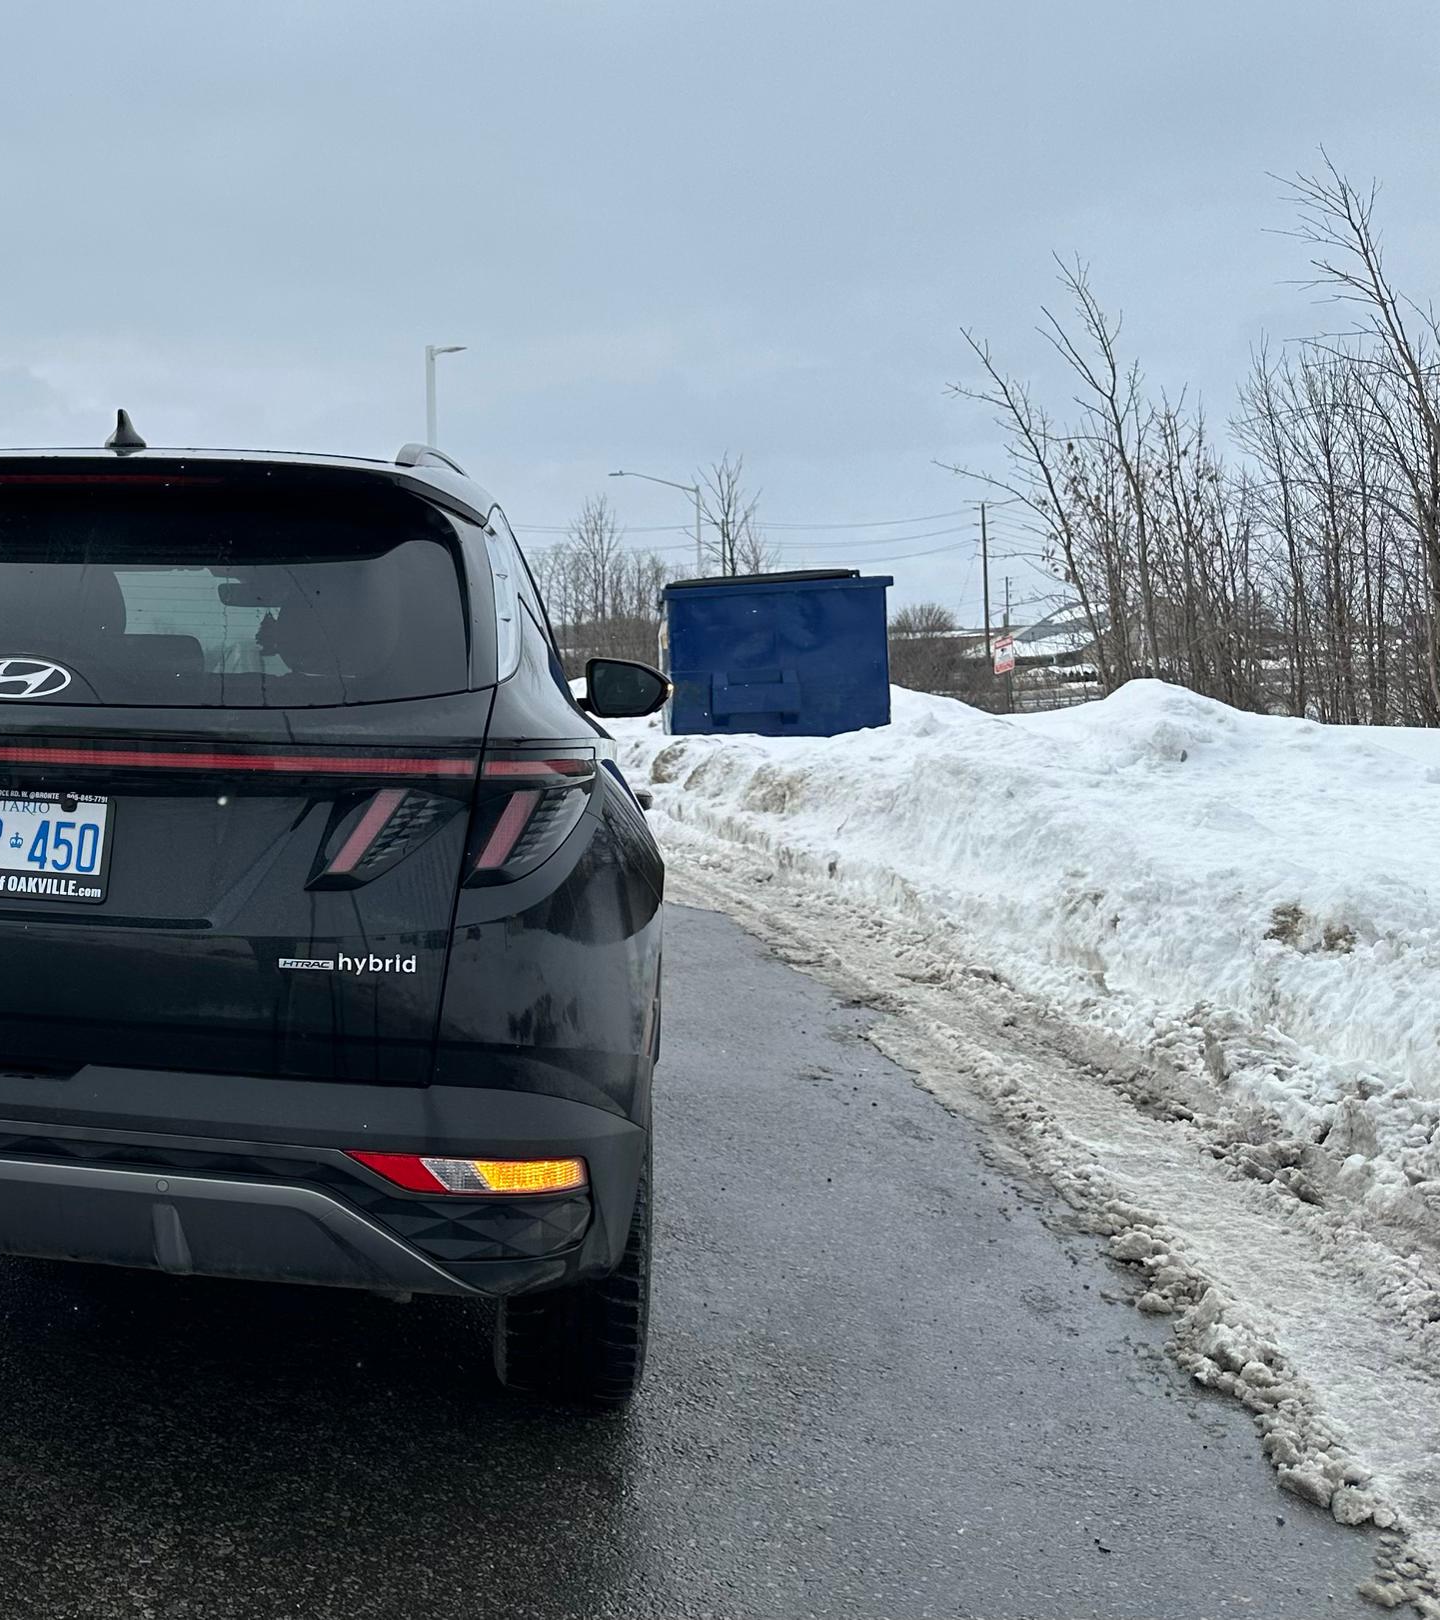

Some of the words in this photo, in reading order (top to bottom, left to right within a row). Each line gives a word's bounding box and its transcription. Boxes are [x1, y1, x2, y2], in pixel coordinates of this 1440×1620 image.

[29, 792, 60, 800] @BRONTE
[27, 820, 100, 873] 450
[7, 876, 101, 898] OAKVILLE.com
[282, 960, 330, 969] HTRAC
[338, 952, 417, 976] hybrid
